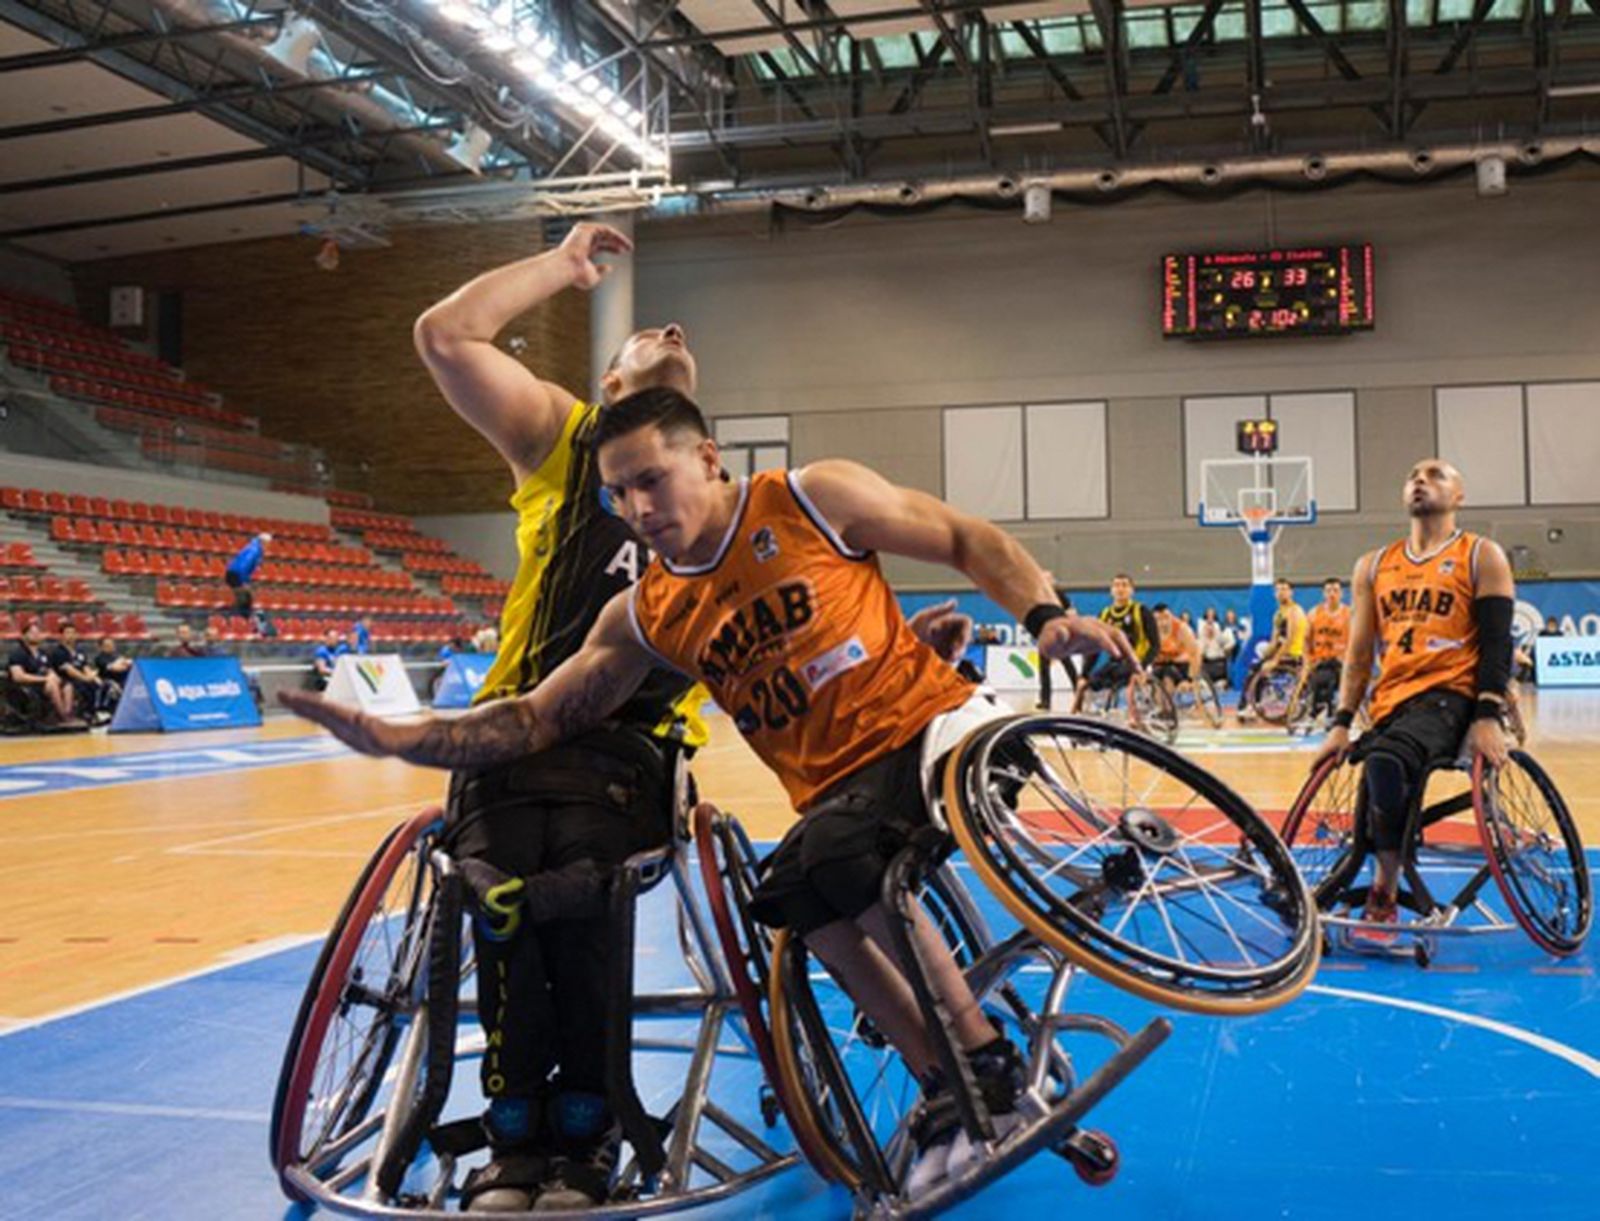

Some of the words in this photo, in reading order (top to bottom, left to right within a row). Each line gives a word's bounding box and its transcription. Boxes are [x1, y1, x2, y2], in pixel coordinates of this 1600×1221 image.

[1230, 270, 1255, 289] 26
[1283, 267, 1307, 287] 33
[604, 539, 656, 581] A
[1379, 586, 1456, 618] AMIAB
[698, 582, 813, 685] AMIAB
[1396, 627, 1415, 655] 4
[751, 664, 808, 731] 20
